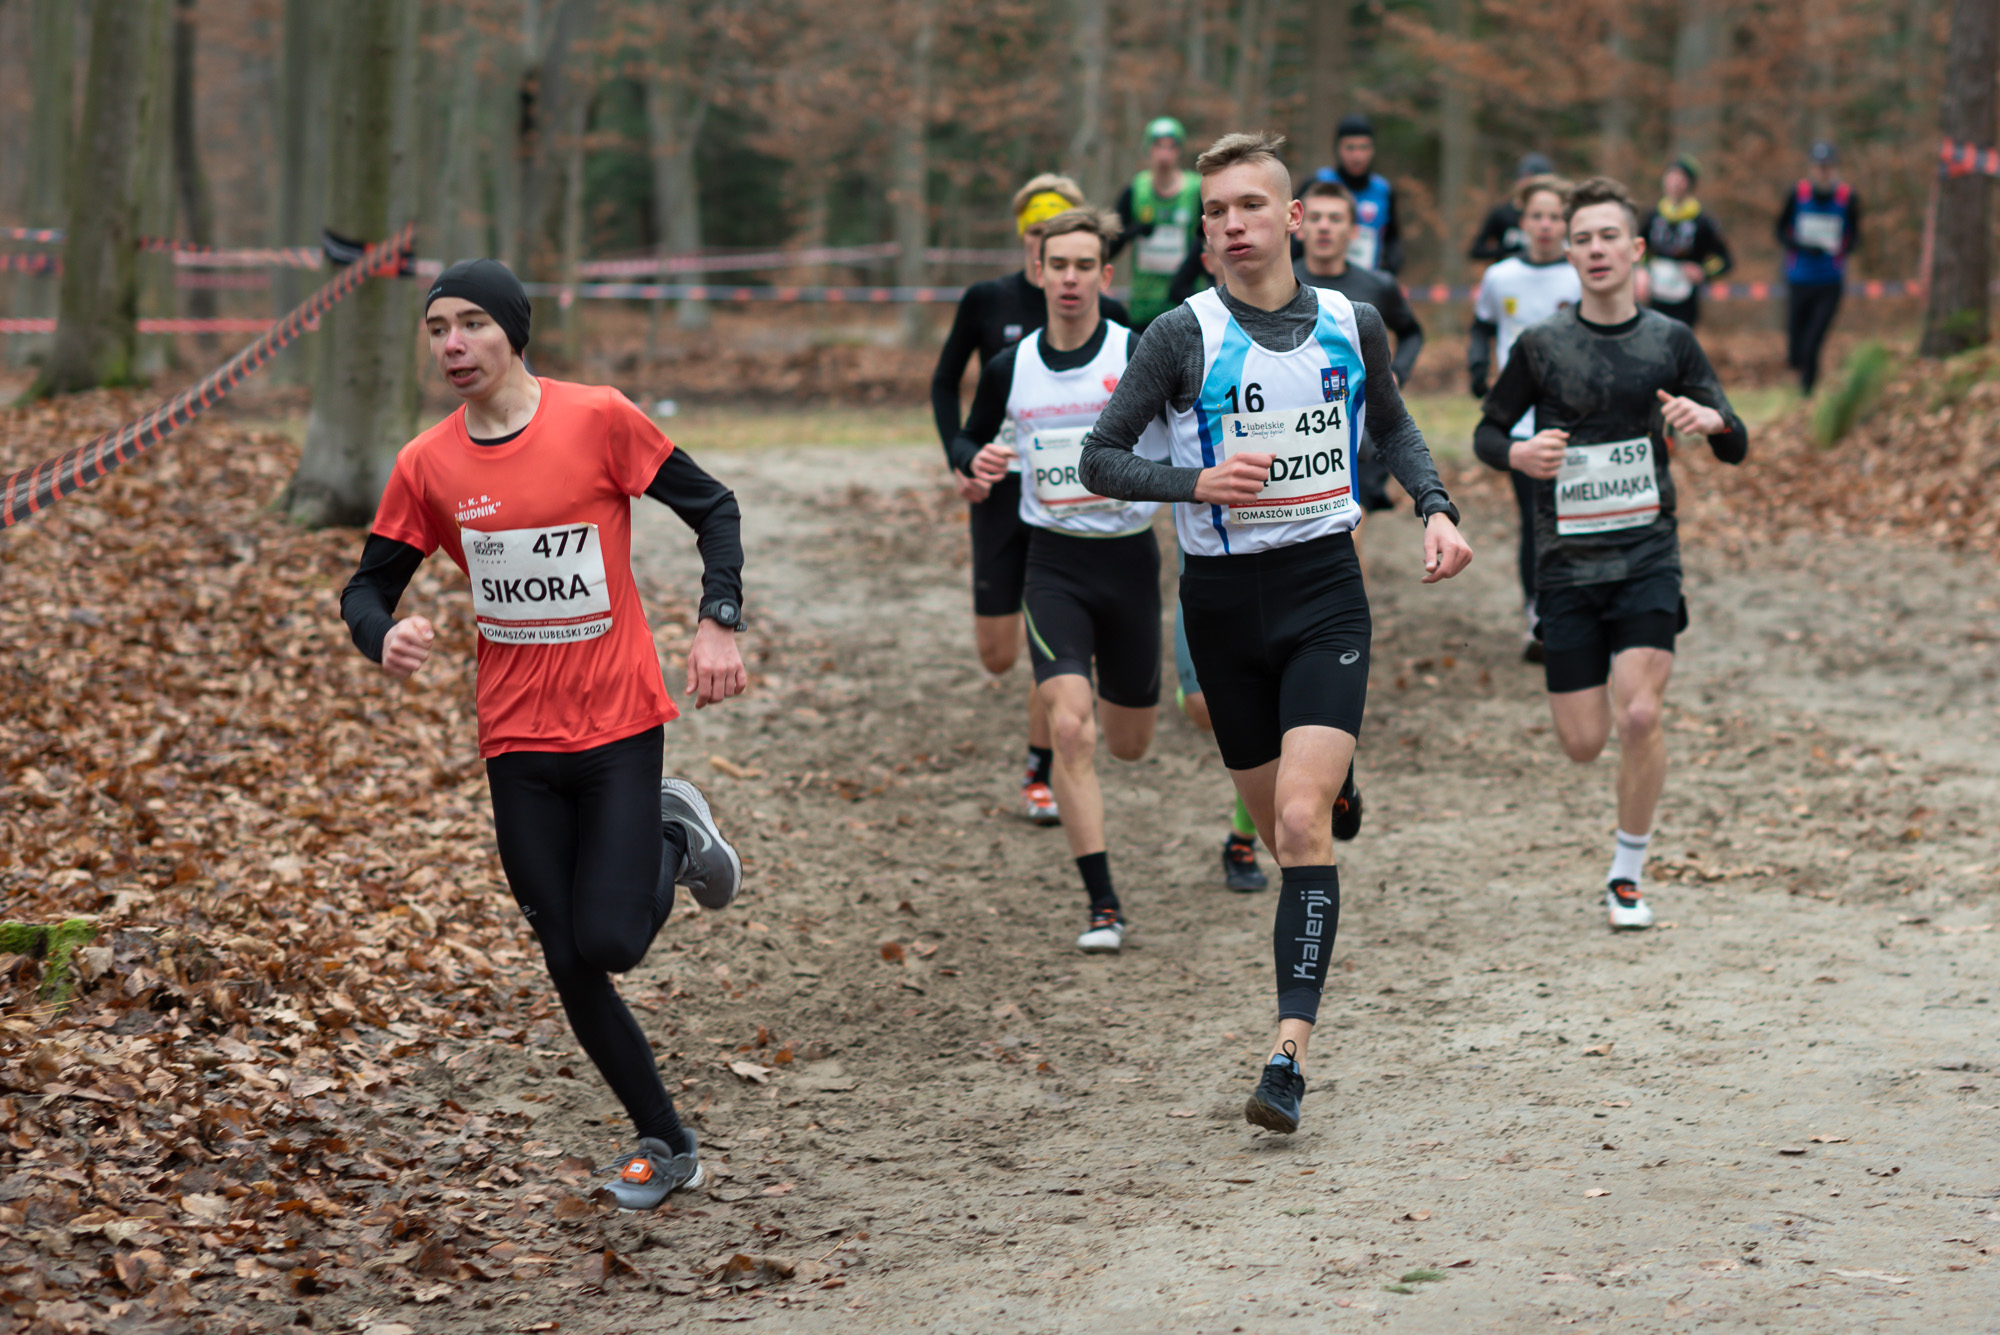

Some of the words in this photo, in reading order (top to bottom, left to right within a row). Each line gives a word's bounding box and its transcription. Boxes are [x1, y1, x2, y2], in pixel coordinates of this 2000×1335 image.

[1225, 382, 1265, 414] 16
[1295, 406, 1342, 436] 434
[1263, 448, 1345, 487] DZIOR
[1609, 443, 1647, 465] 459
[1561, 475, 1653, 502] MIELIMĄKA
[1237, 508, 1292, 520] TOMASZÓW
[1295, 502, 1331, 517] LUBELSKI
[1333, 498, 1349, 509] 2021
[531, 527, 589, 559] 477
[481, 573, 590, 603] SIKORA
[483, 627, 536, 640] TOMASZÓW
[539, 629, 581, 639] LUBELSKI
[584, 623, 607, 635] 2021
